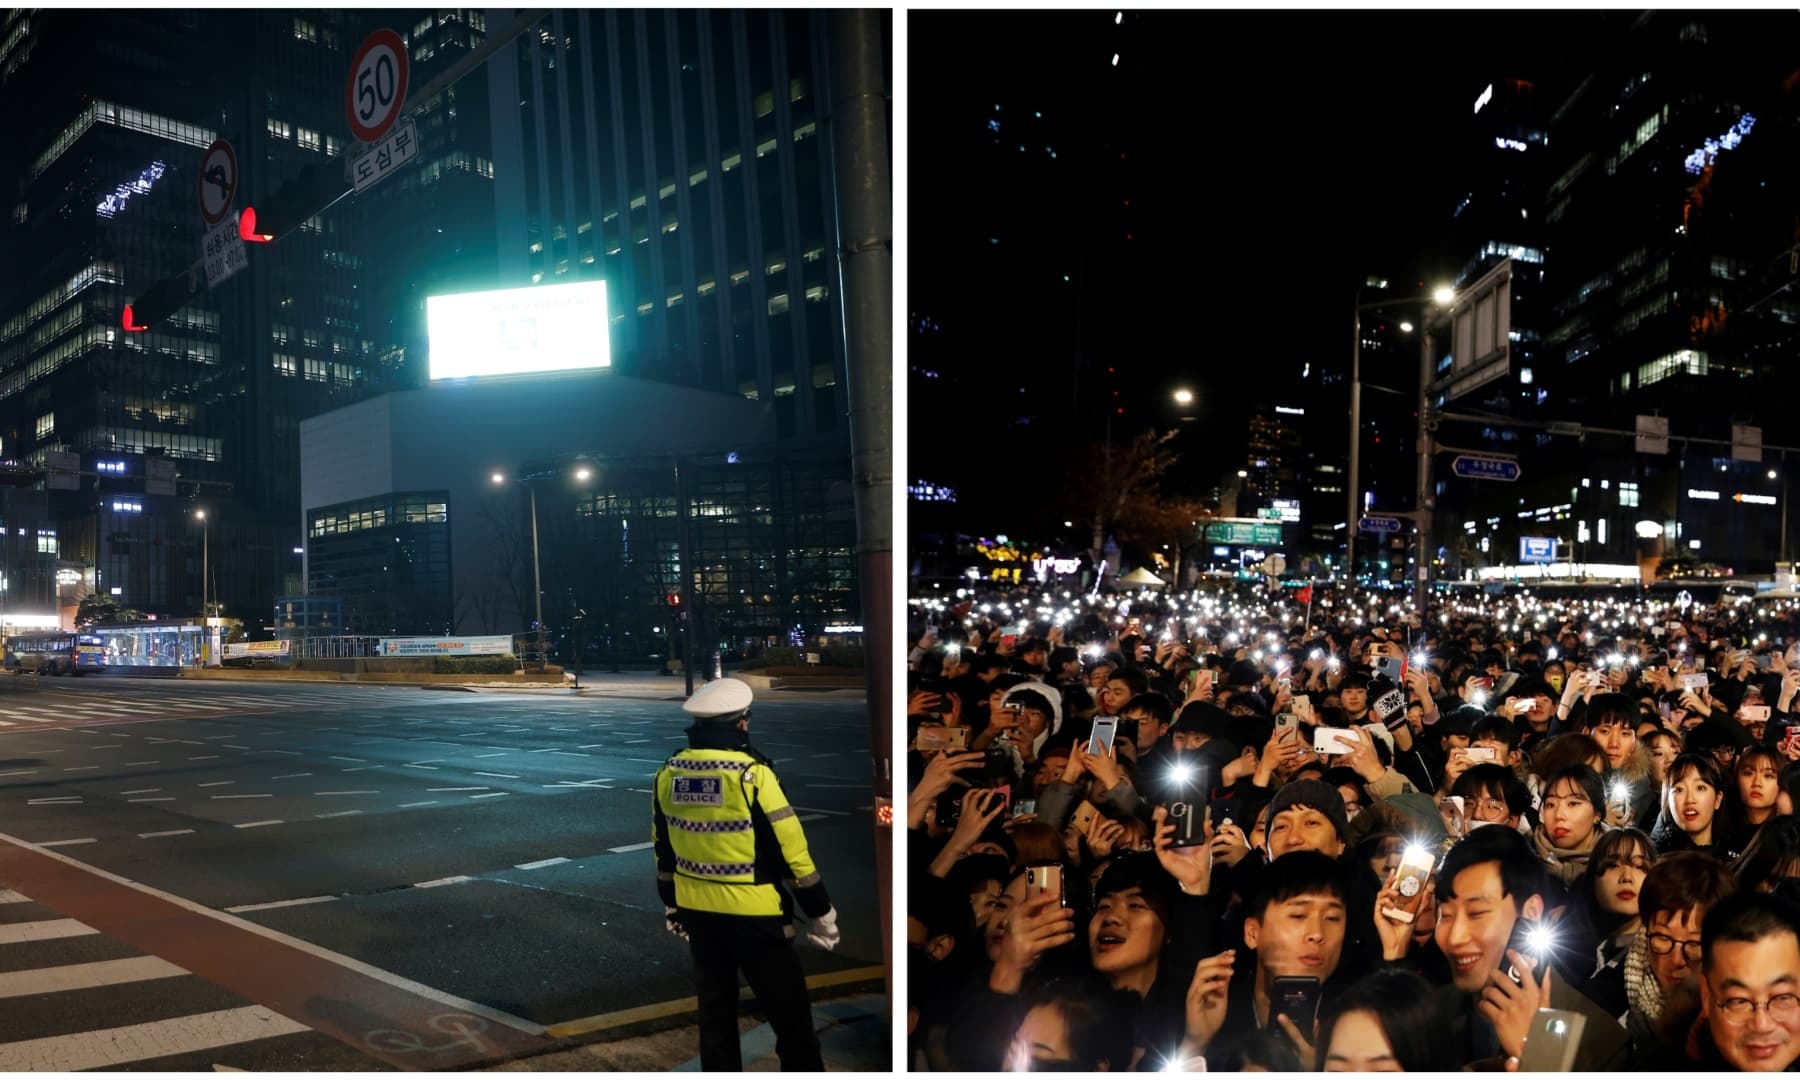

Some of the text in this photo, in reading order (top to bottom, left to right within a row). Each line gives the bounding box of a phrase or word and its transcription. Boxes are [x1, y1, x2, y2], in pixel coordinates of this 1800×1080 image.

[358, 54, 394, 121] 50
[357, 131, 412, 184] 도심부
[676, 794, 716, 803] POLICE
